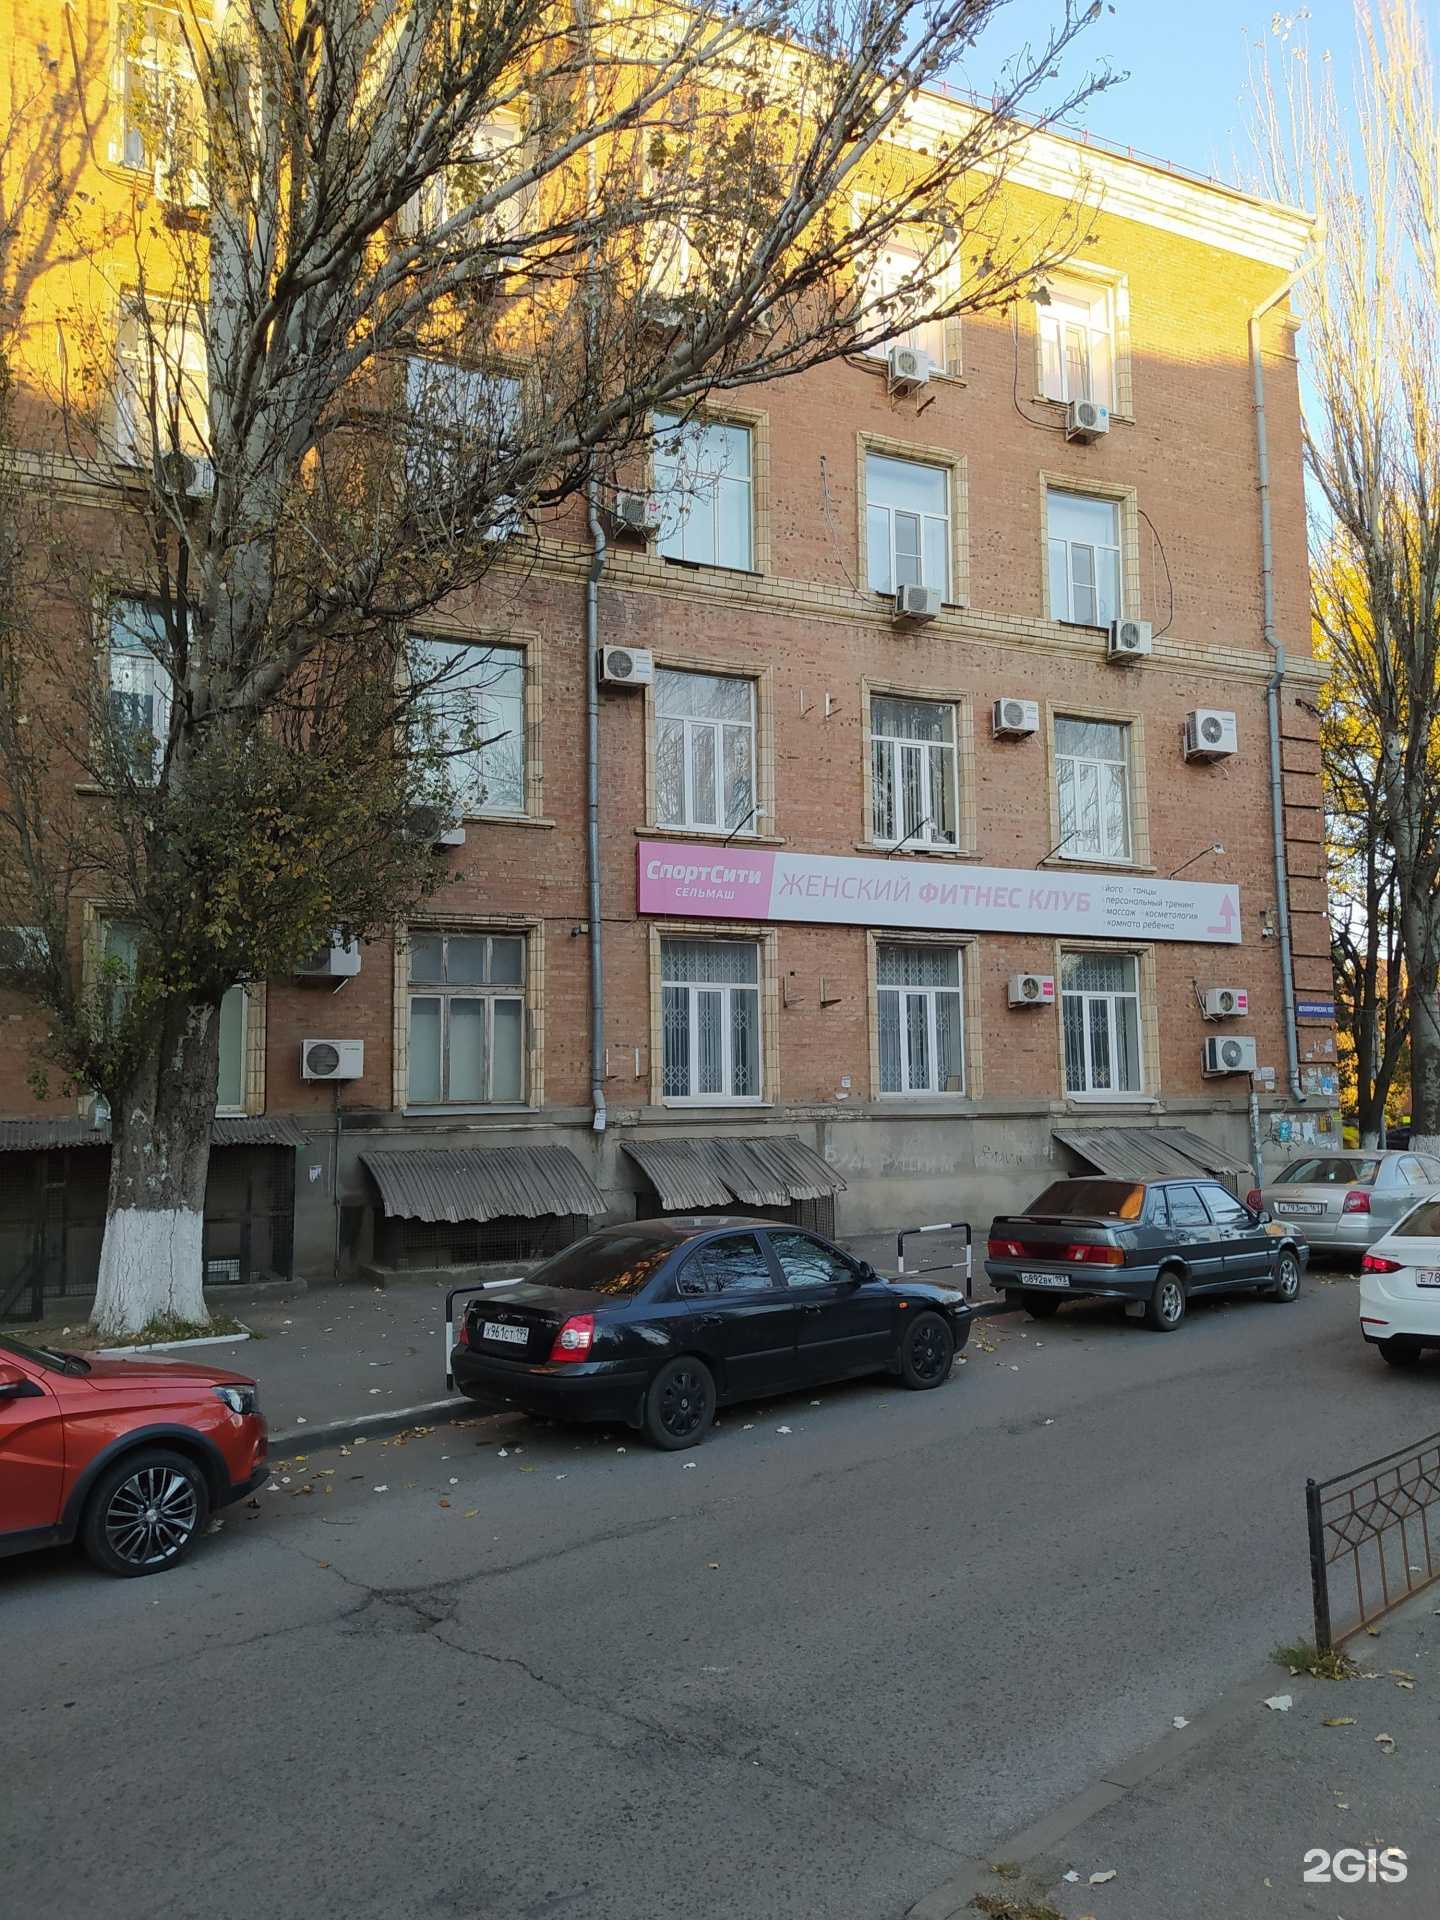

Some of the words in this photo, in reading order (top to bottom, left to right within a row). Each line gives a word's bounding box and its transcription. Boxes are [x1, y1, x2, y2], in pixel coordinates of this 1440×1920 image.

[646, 860, 762, 885] СпортСити
[674, 887, 736, 900] СЕЛЬМАШ
[779, 872, 911, 903] ЖЕНСКИЙ
[919, 882, 1023, 909] ФИТНЕС
[1028, 889, 1091, 913] КЛУБ
[1133, 887, 1157, 896] танцы
[1105, 896, 1163, 907] персональный
[1106, 908, 1136, 917] массаж
[1145, 910, 1198, 920] косметология
[1107, 919, 1140, 929] комната
